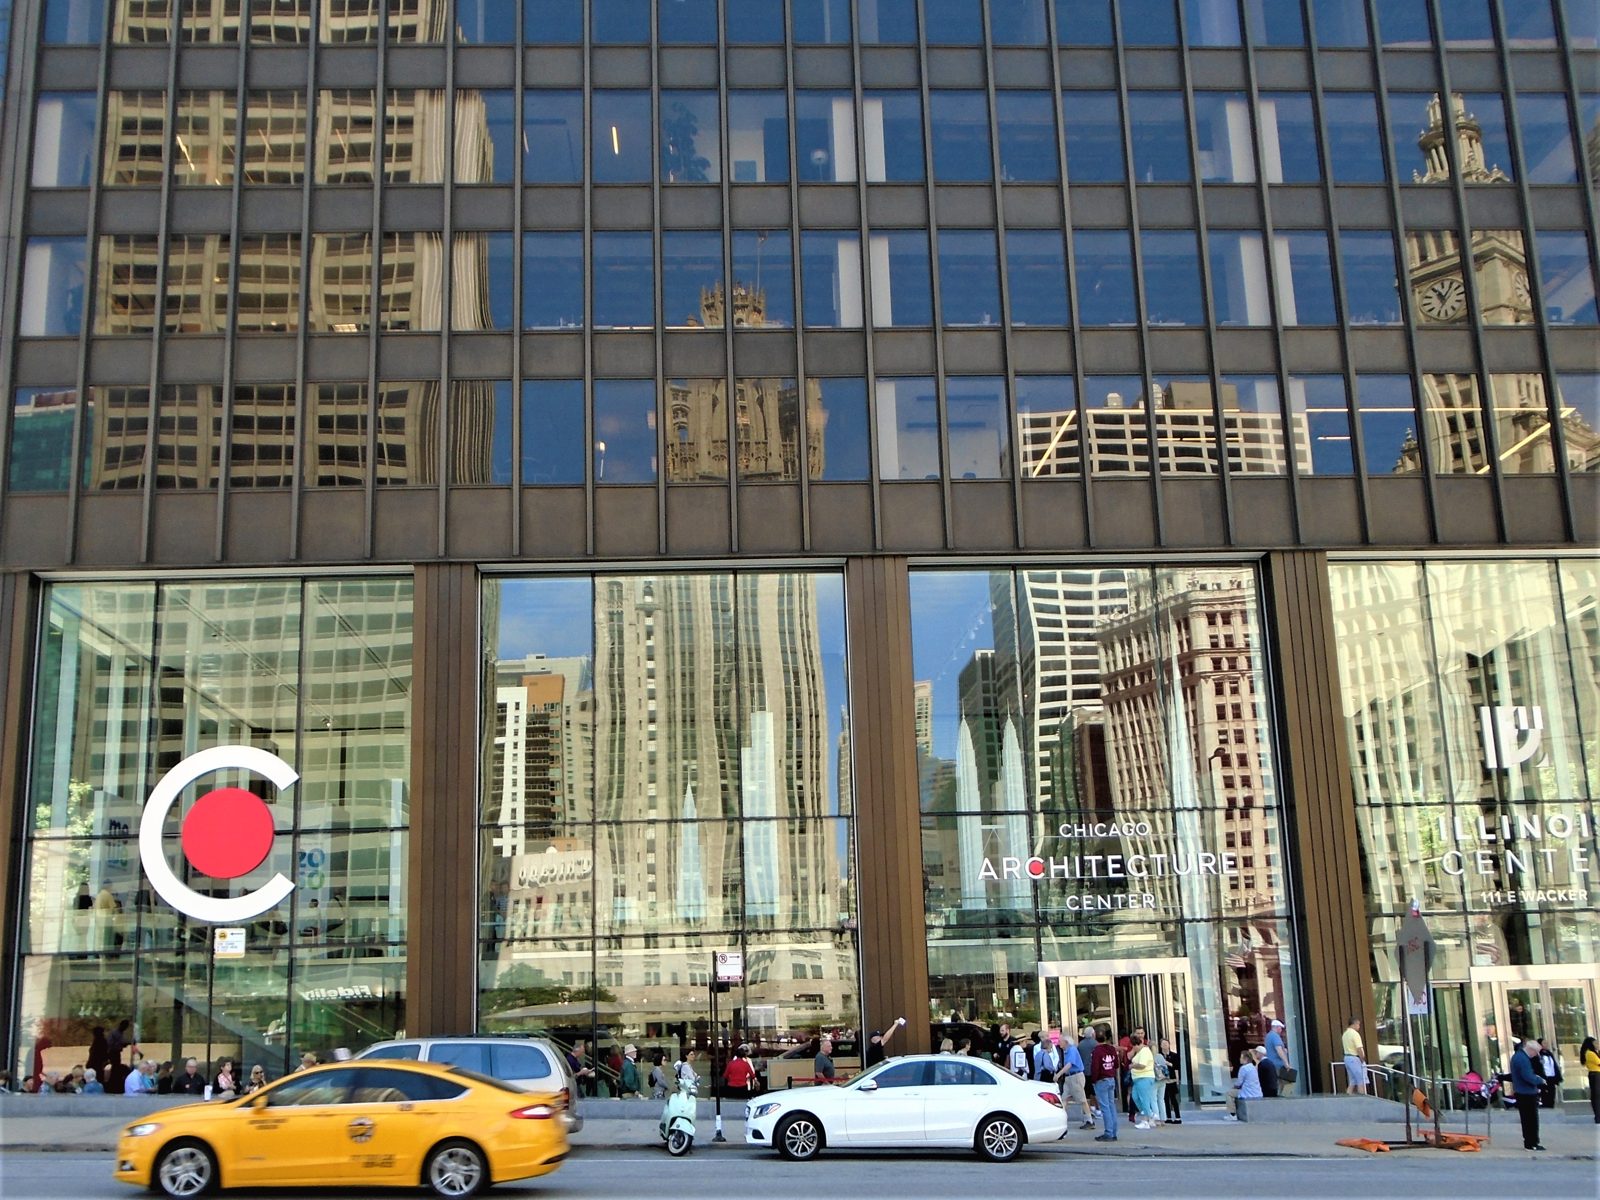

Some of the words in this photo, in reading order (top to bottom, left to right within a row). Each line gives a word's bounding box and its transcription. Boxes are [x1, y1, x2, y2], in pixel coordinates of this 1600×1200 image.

[1058, 822, 1151, 838] CHICAGO
[977, 852, 1239, 881] ARCHITECTURE
[1066, 893, 1155, 910] CENTER
[1480, 890, 1502, 903] 111
[1507, 890, 1517, 903] E
[1522, 888, 1588, 902] WACKER
